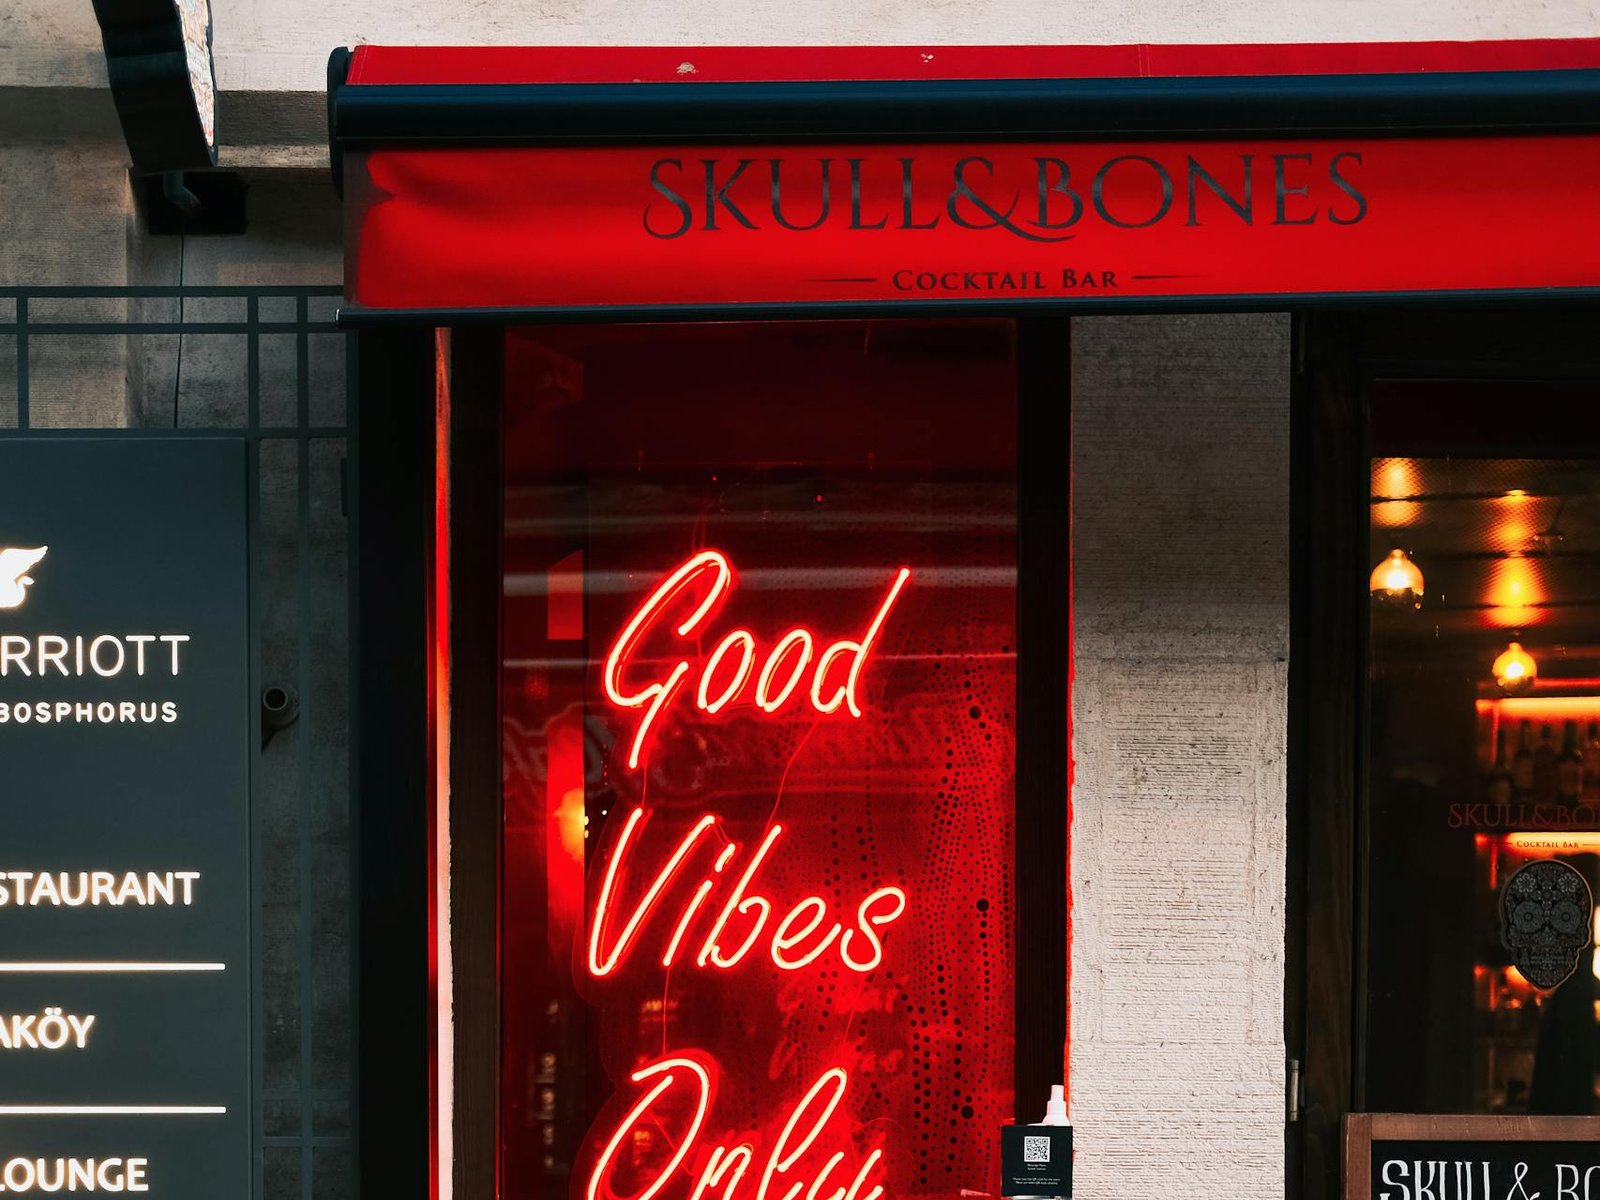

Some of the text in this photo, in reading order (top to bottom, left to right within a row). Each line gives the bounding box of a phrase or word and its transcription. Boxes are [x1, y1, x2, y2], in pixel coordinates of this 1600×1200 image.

[892, 269, 1117, 291] COCKTAIL BAR
[0, 635, 190, 676] RRIOTT
[603, 549, 911, 770] Good
[588, 805, 905, 976] Vibes
